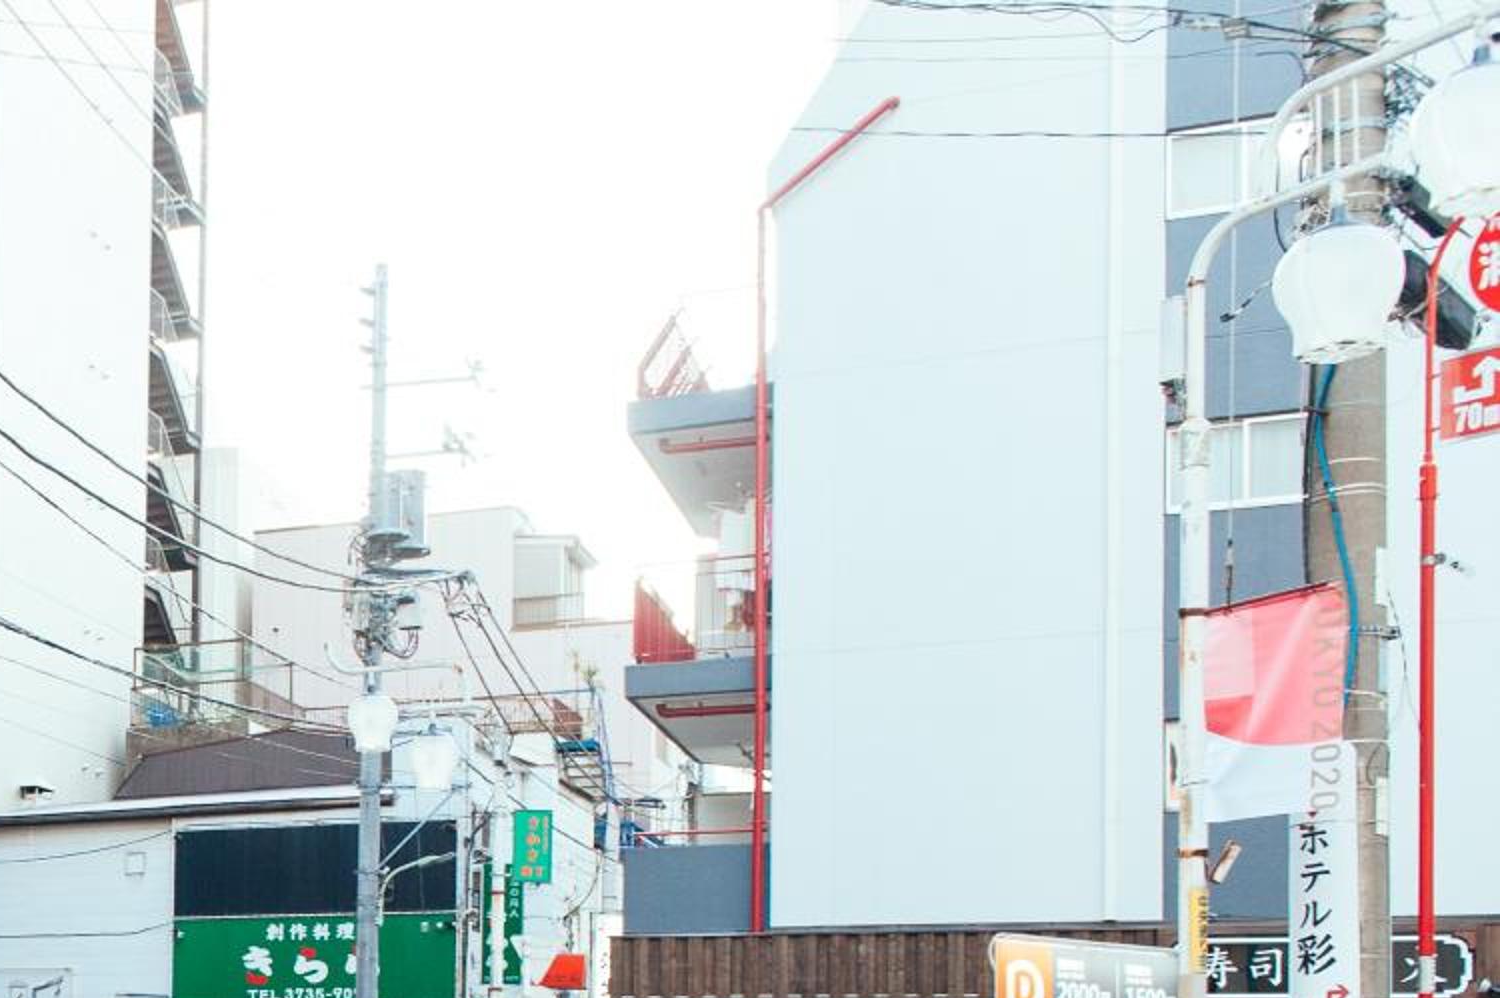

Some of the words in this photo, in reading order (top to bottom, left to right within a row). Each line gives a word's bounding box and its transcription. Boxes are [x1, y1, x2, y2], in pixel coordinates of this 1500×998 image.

[266, 922, 356, 941] 創作料理
[1297, 824, 1337, 976] ホテル彩
